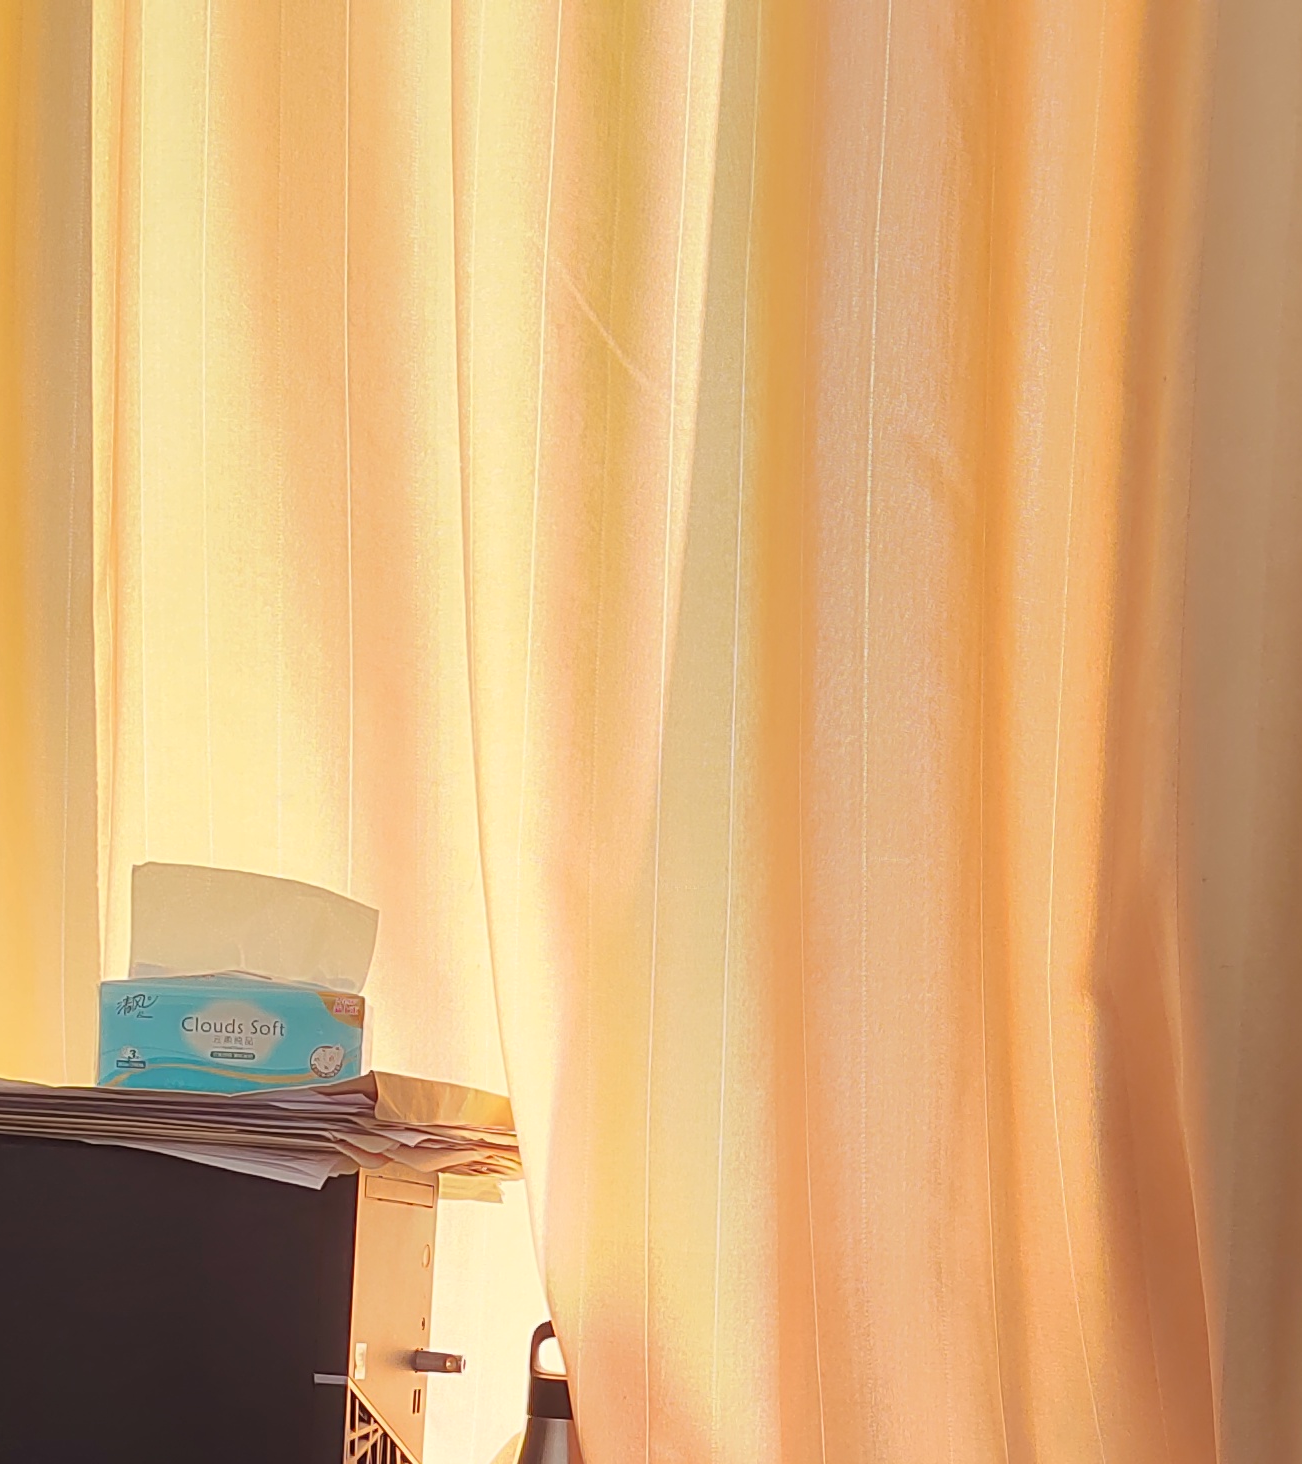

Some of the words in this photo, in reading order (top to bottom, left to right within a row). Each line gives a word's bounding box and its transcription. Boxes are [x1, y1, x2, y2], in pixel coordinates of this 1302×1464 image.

[115, 993, 159, 1017] 清风
[181, 1016, 243, 1035] Clouds
[250, 1019, 286, 1037] Soft
